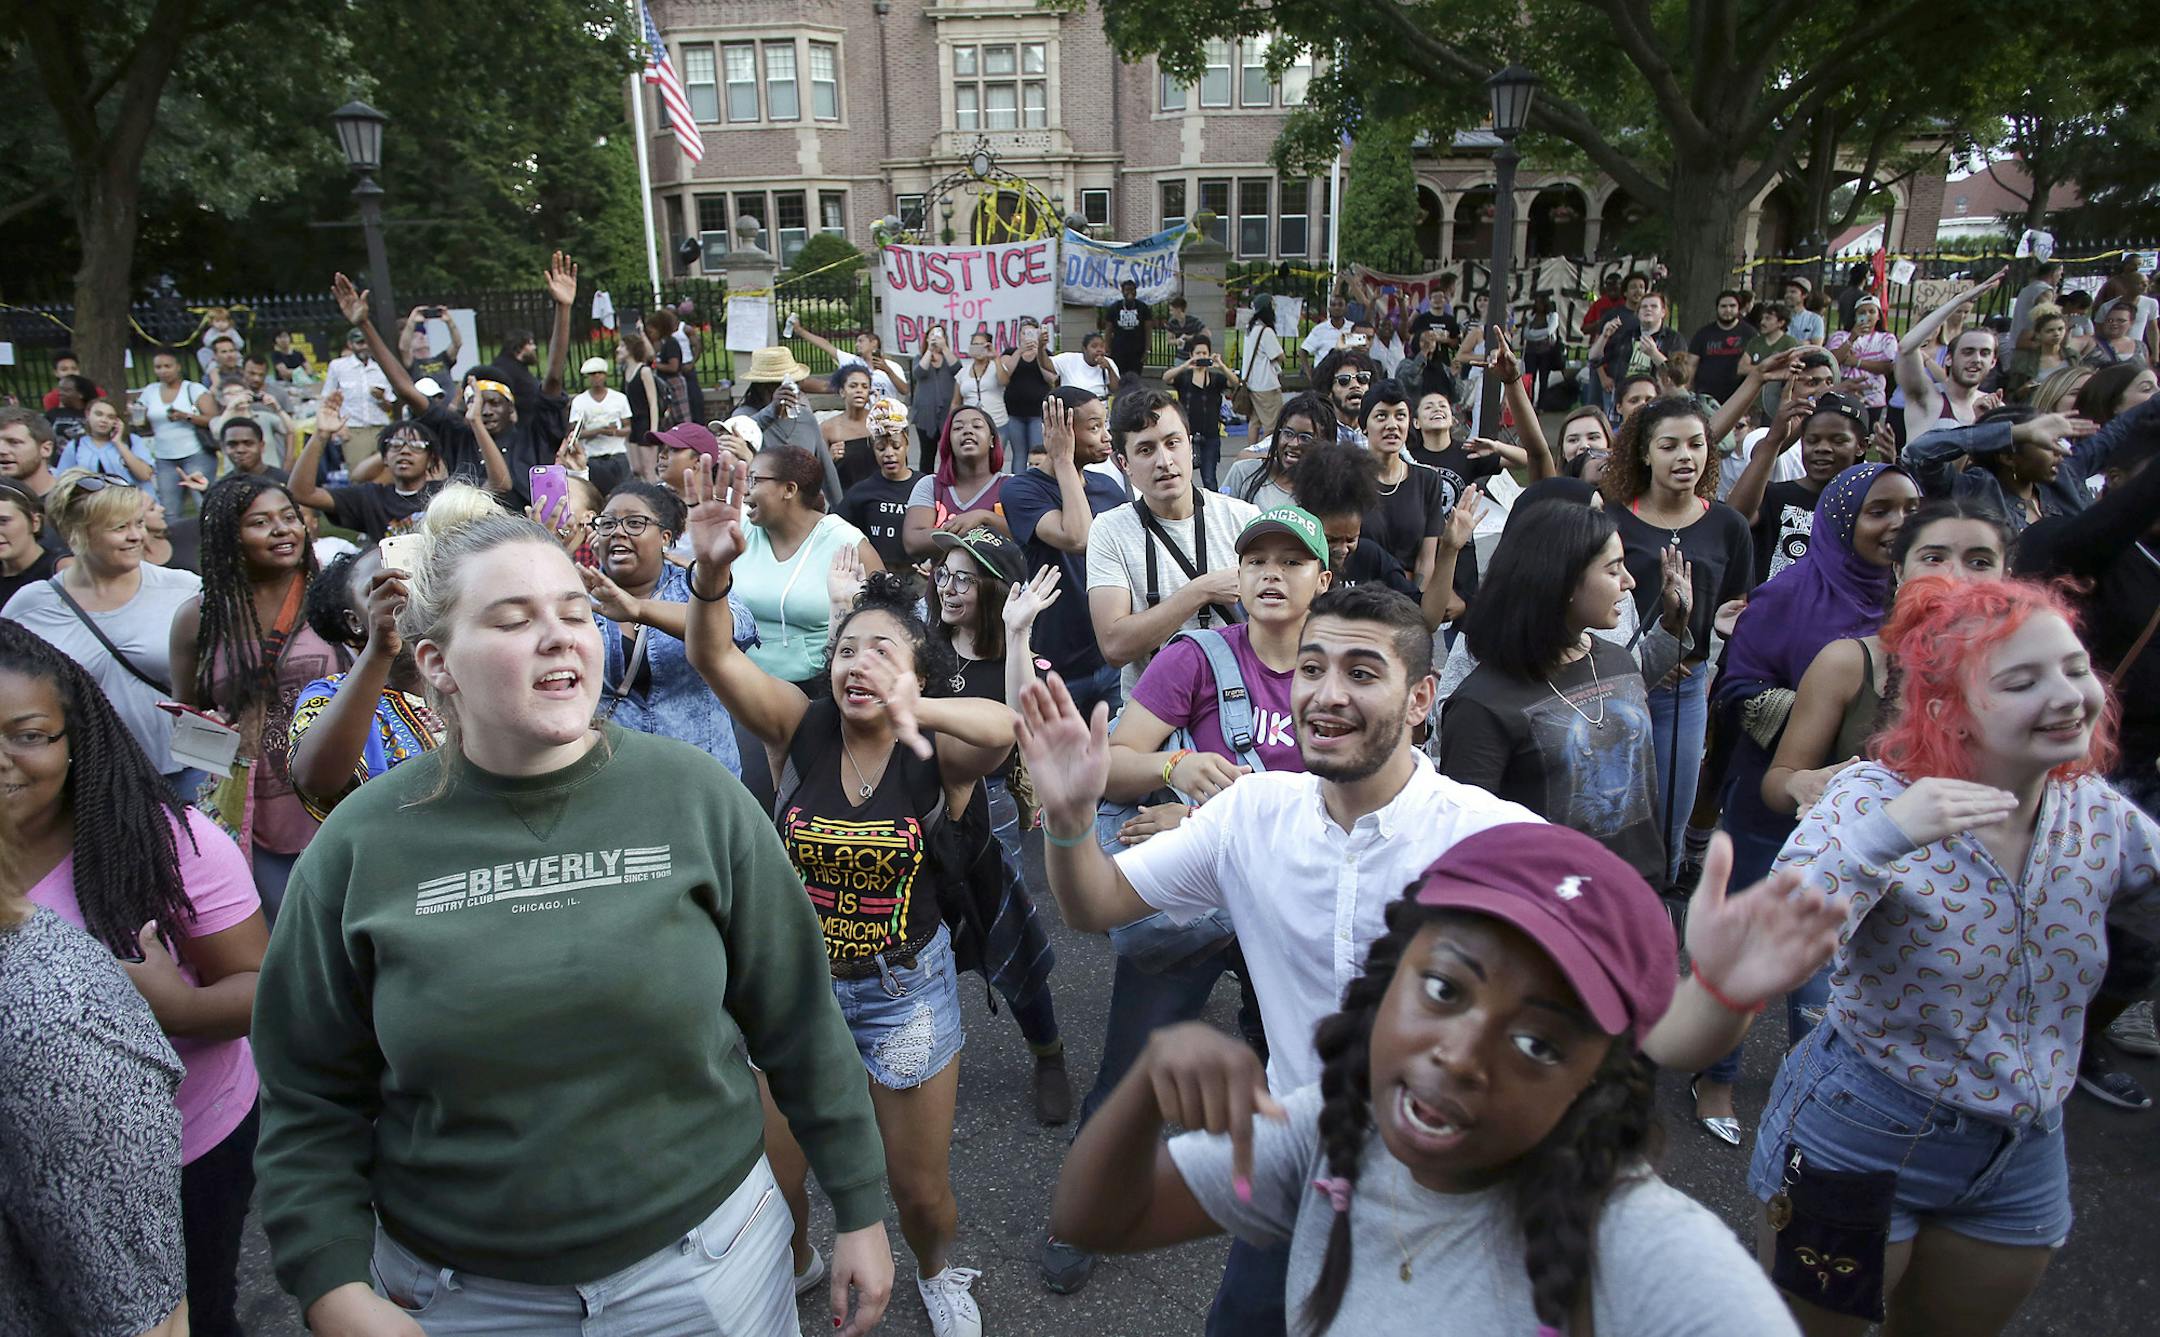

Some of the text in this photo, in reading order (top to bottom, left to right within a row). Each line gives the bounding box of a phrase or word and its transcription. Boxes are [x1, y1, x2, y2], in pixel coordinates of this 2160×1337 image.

[884, 243, 1052, 294] JUSTICE
[943, 291, 992, 321] for
[798, 843, 896, 875] BLACK
[469, 849, 622, 898] BEVERLY
[623, 872, 649, 884] SINCE
[812, 865, 896, 892] HISTORY
[415, 894, 494, 916] COUNTRY CLUB
[511, 898, 581, 914] CHICAGO, IL.
[838, 890, 858, 915] IS
[818, 914, 889, 941] MERICAN
